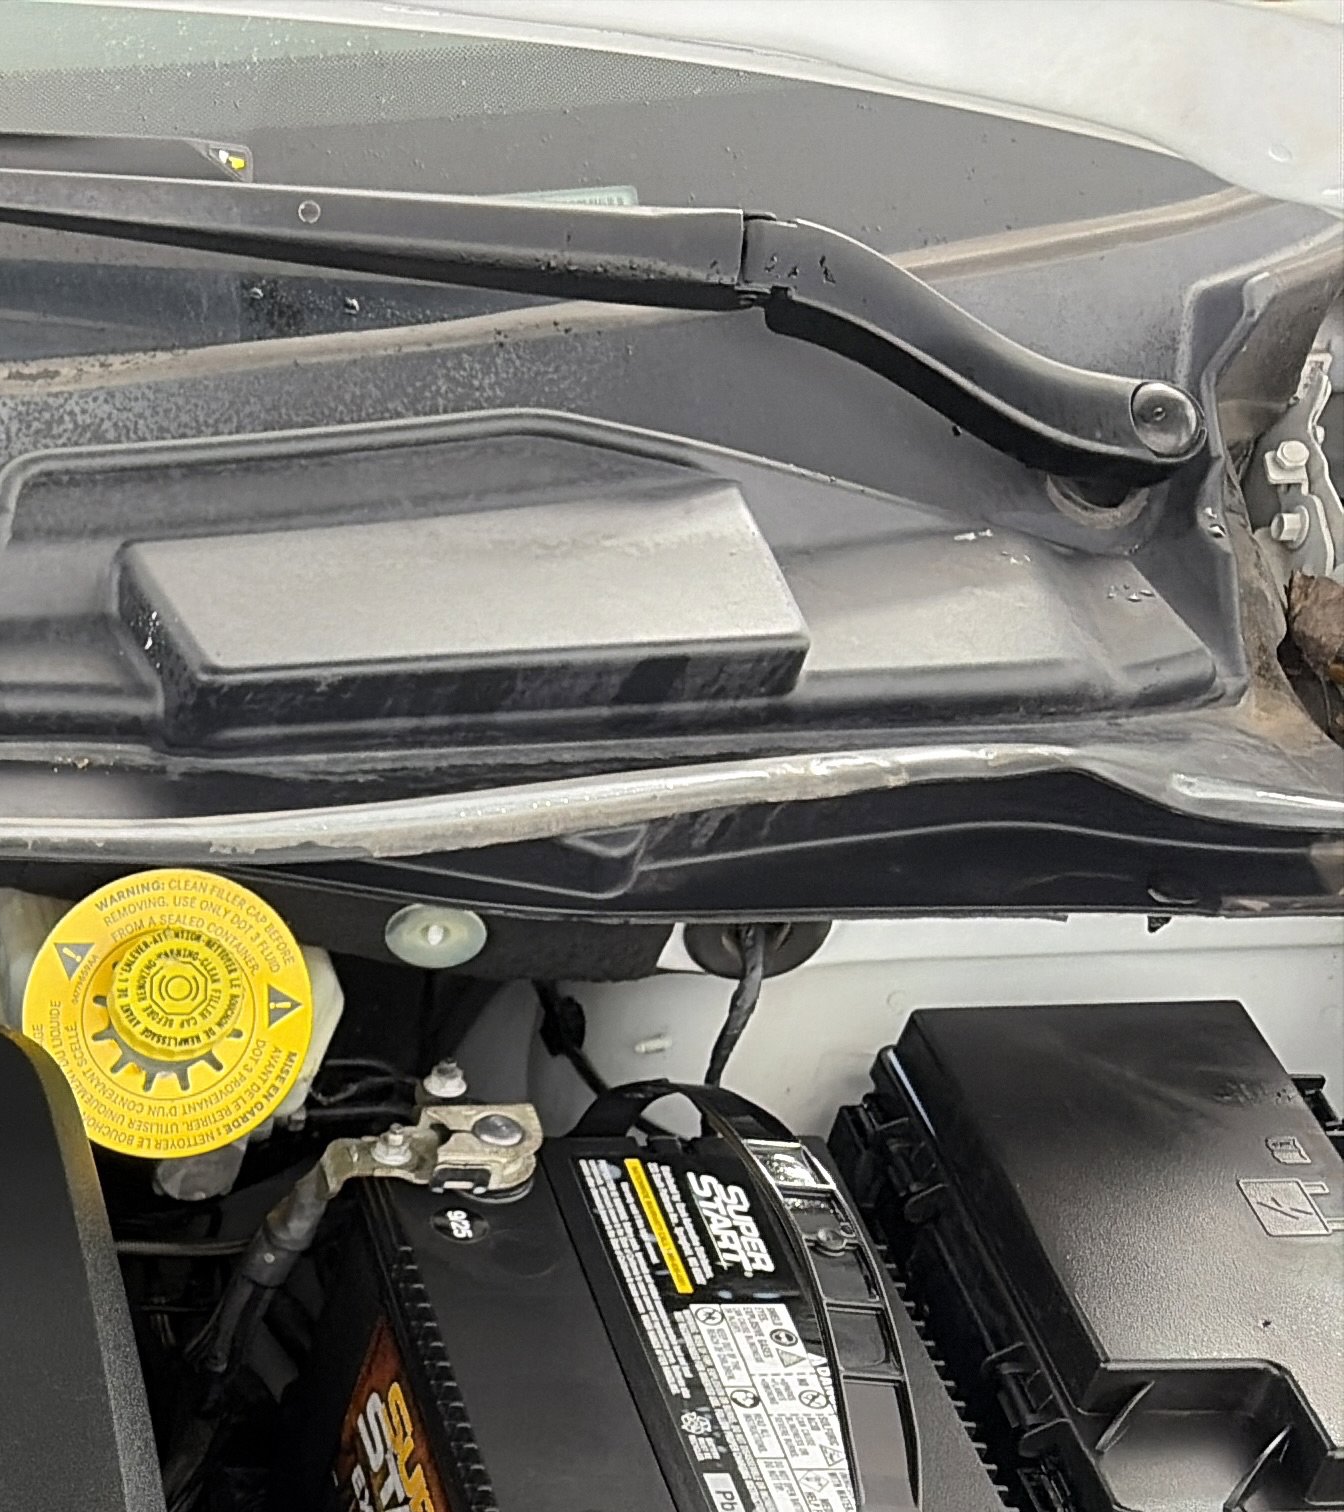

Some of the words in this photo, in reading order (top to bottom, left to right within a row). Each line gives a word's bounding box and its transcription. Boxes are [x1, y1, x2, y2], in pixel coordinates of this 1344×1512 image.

[95, 880, 165, 912] WARNING:
[169, 879, 208, 892] CLEAN
[211, 885, 246, 910] FILLER
[246, 905, 267, 924] CAP
[264, 922, 295, 966] BEFORE
[103, 896, 169, 927] REMOVING.
[173, 895, 198, 907] USE
[199, 898, 231, 919] ONLY
[230, 910, 253, 934] DOT
[256, 941, 281, 973] FLUID
[111, 921, 145, 943] FROM
[148, 916, 157, 927] A
[160, 914, 205, 929] SEALED
[49, 1000, 62, 1049] LIQUIDE
[250, 1039, 266, 1064] DOT
[259, 1047, 282, 1085] AVANT
[275, 1051, 298, 1085] MISE
[82, 1068, 144, 1114] CONTENANT
[182, 1072, 247, 1116] PROVENANT
[234, 1095, 247, 1111] LE
[244, 1083, 261, 1099] DE
[263, 1085, 279, 1102] EN
[148, 1104, 178, 1117] D'UN
[128, 1120, 179, 1135] UTILISER
[155, 1132, 216, 1151] NETTOYER
[137, 1137, 151, 1150] LE
[686, 1170, 748, 1276] START
[717, 1183, 775, 1273] SUPER
[715, 1489, 739, 1512] Pb
